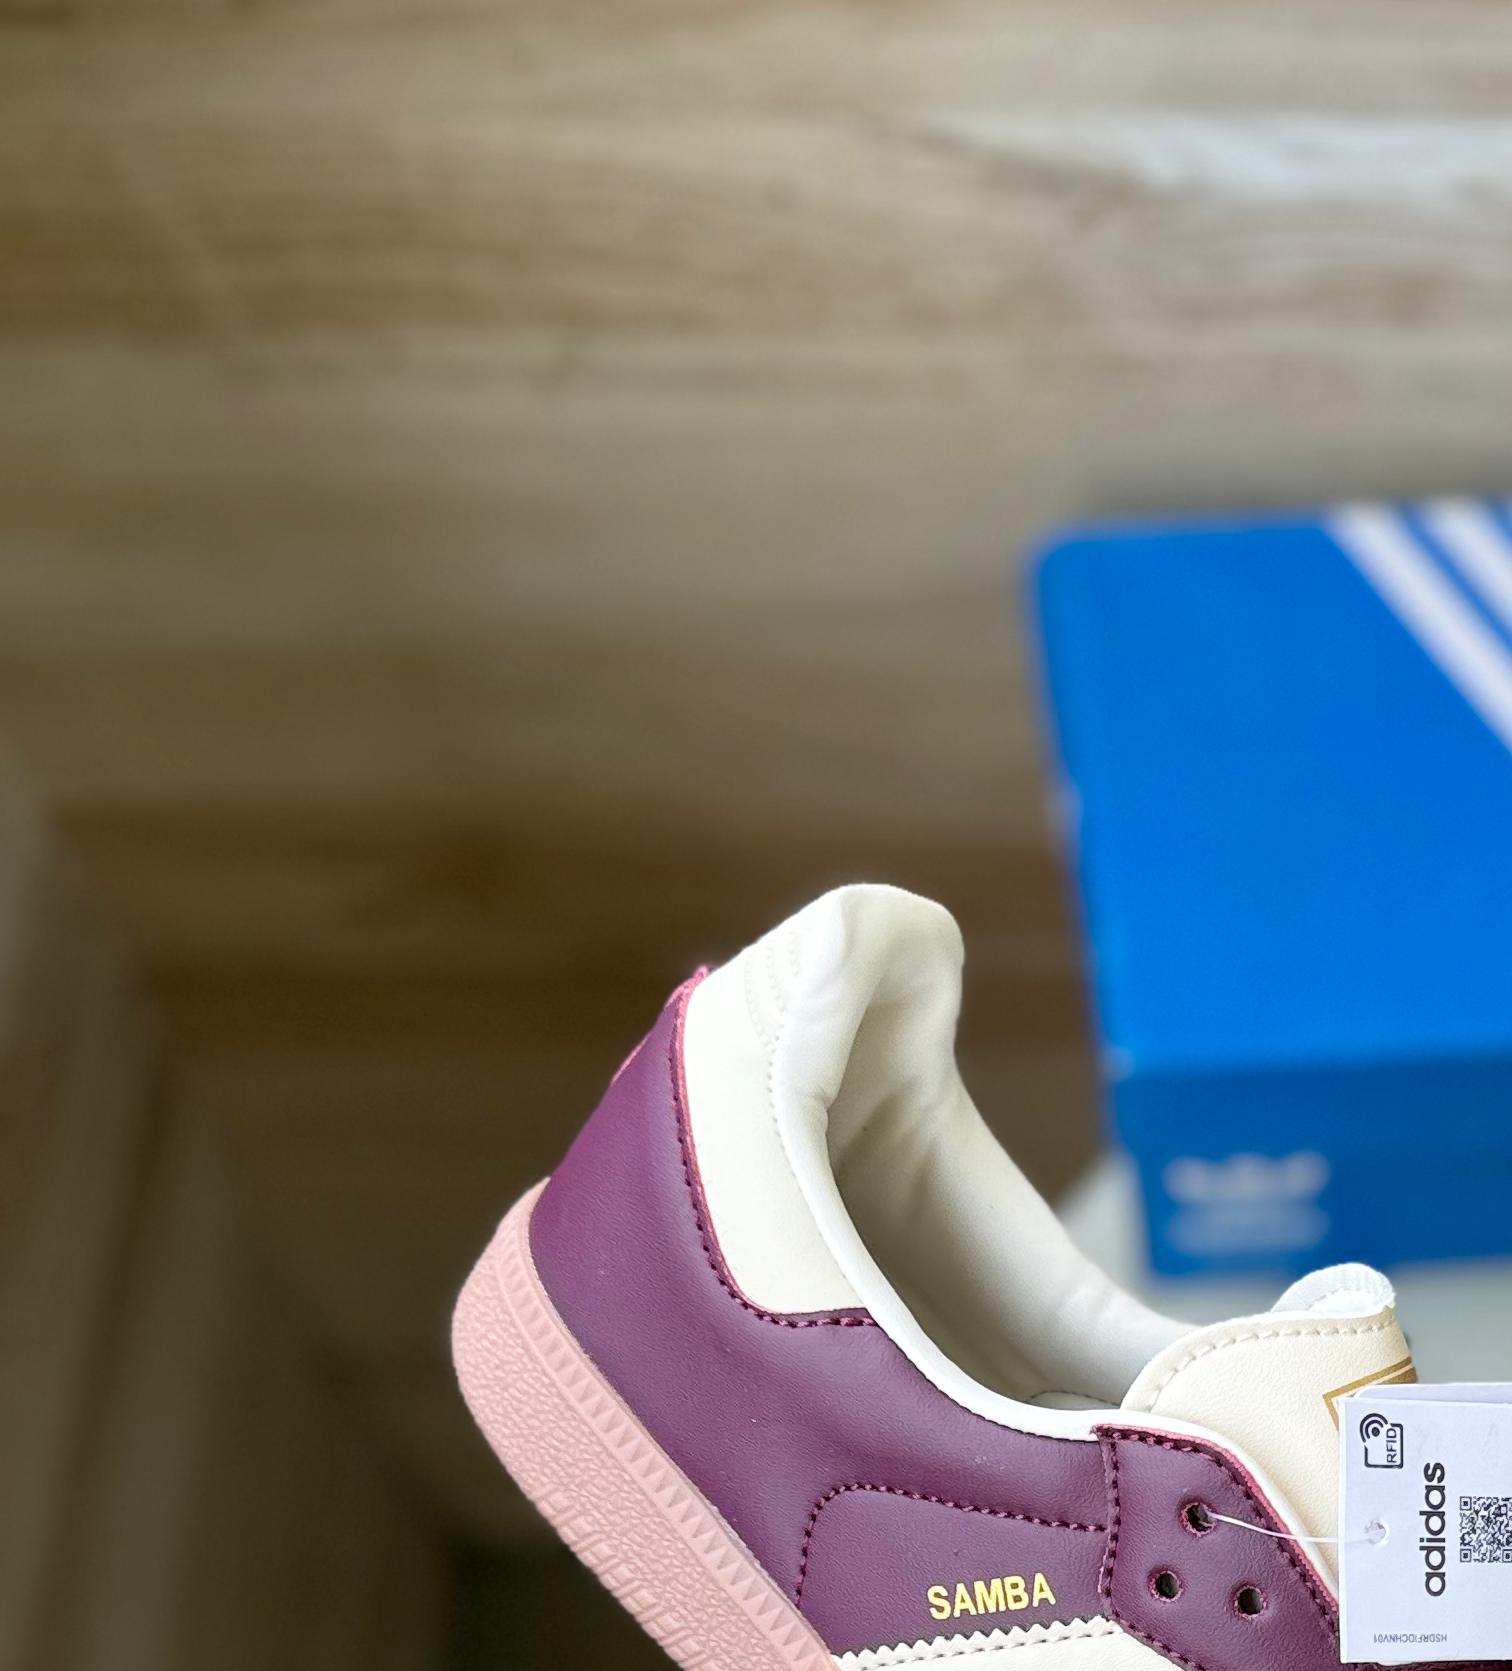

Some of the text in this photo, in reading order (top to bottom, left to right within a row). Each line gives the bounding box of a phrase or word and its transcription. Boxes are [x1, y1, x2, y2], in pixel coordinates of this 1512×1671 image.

[1386, 1427, 1397, 1464] RFID
[1419, 1462, 1446, 1597] adidas
[927, 1572, 1056, 1620] SAMBA
